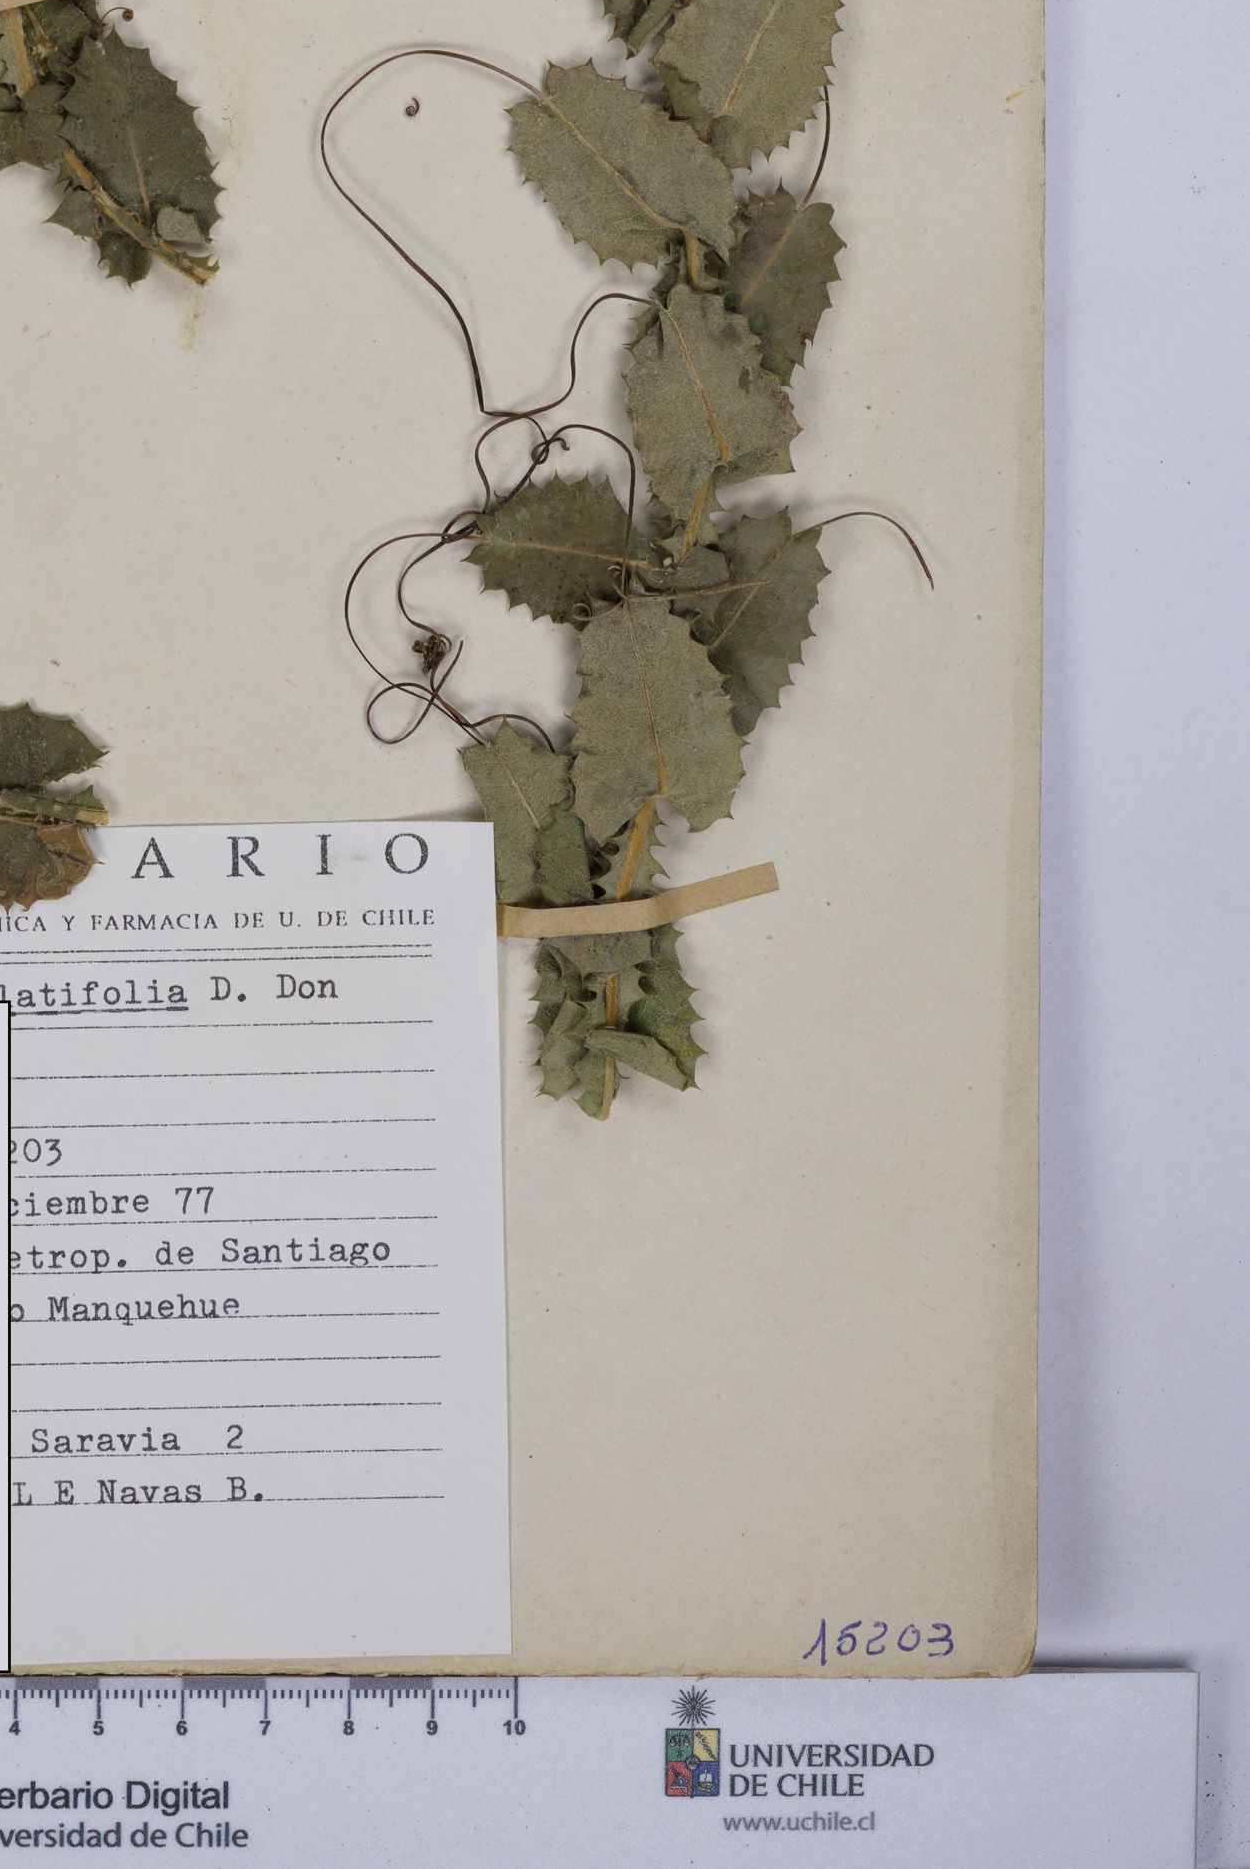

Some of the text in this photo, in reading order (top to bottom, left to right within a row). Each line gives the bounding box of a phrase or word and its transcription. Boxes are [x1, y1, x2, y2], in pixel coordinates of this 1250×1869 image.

[61, 915, 75, 932] Y
[90, 913, 218, 931] FARMACIA
[234, 911, 264, 929] DE
[278, 911, 301, 928] U.
[317, 910, 348, 927] DE
[361, 908, 435, 926] CHILE
[209, 976, 247, 1002] D.
[276, 973, 339, 1000] Don
[174, 1186, 215, 1215] 77
[11, 1237, 391, 1274] etrop. de Santiago
[47, 1293, 240, 1326] Manquehue
[31, 1424, 243, 1453] Saravia 2
[12, 1476, 264, 1506] L E Navas B.
[8, 1720, 22, 1736] 4
[92, 1720, 105, 1736] 5
[175, 1720, 189, 1736] 6
[258, 1720, 272, 1736] 7
[342, 1720, 355, 1736] 8
[425, 1720, 439, 1736] 9
[502, 1720, 527, 1736] 10
[729, 1743, 935, 1769] UNIVERSIDAD
[125, 1780, 230, 1817] Digital
[729, 1773, 865, 1798] DE CHILE
[129, 1821, 168, 1849] de
[174, 1821, 249, 1848] Chile
[723, 1811, 875, 1831] www.uchile.cl
